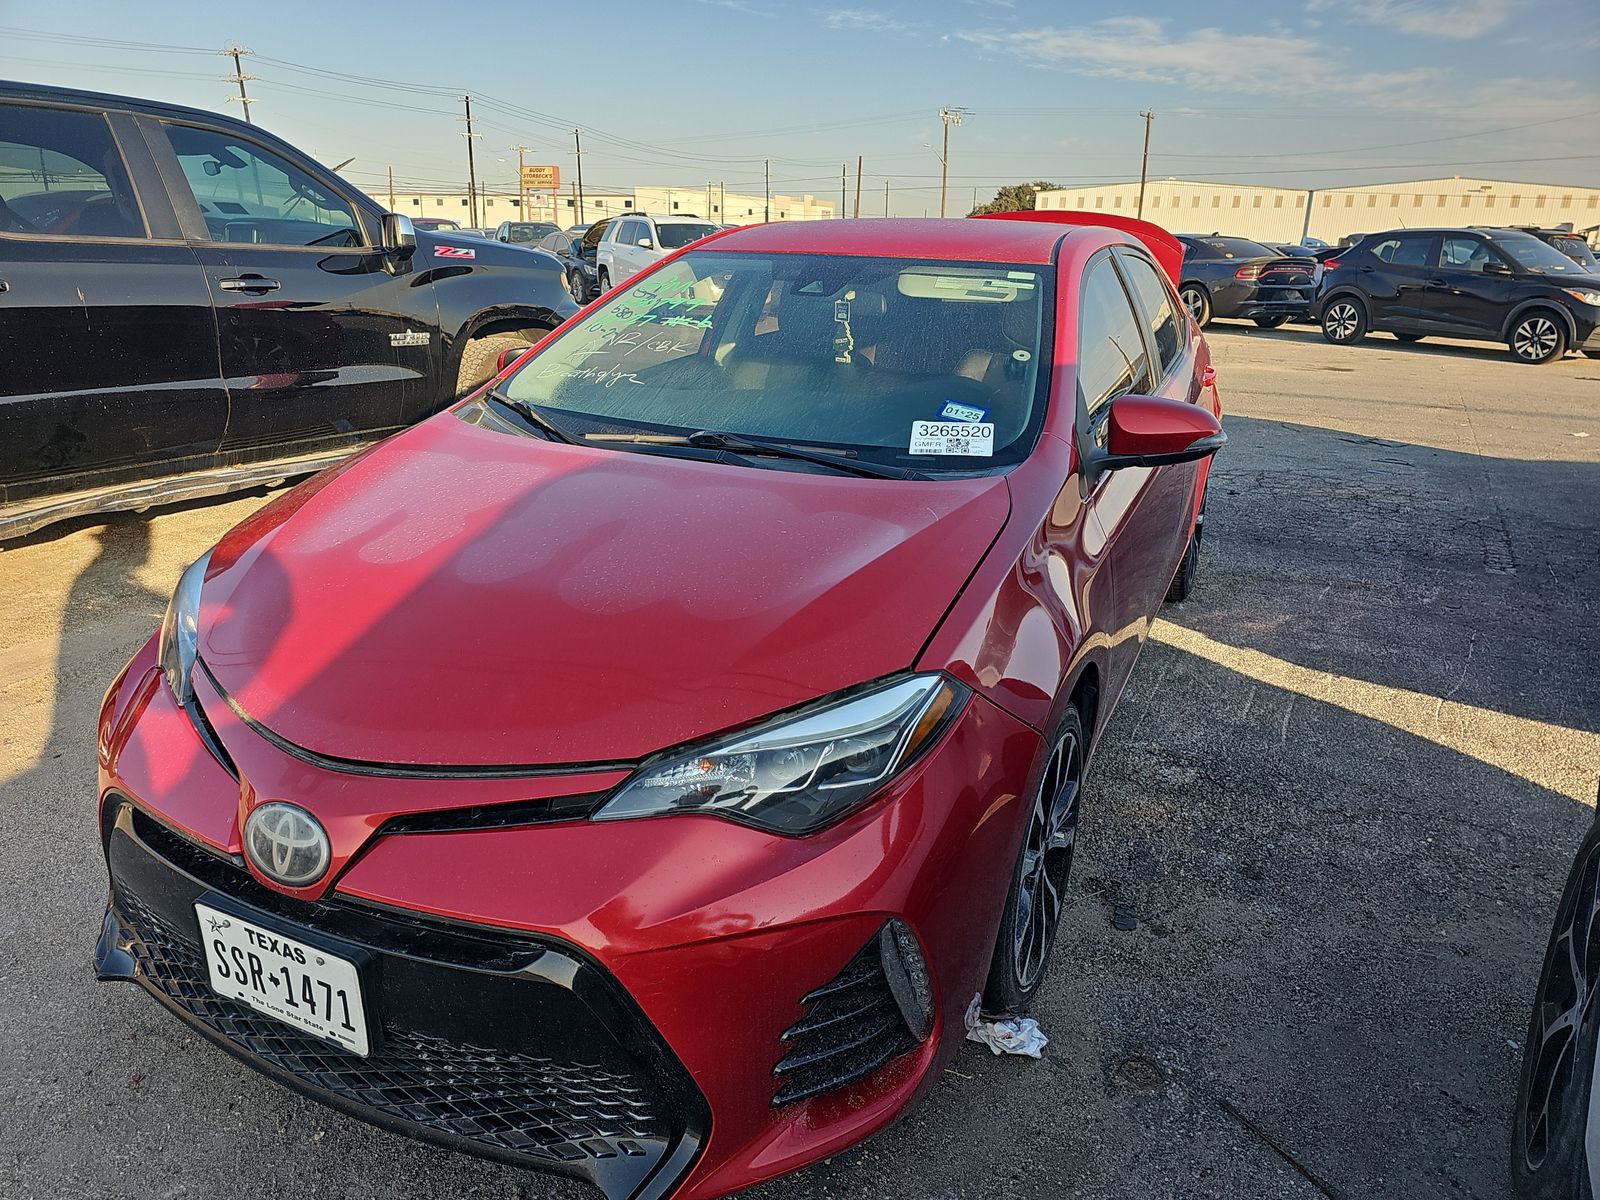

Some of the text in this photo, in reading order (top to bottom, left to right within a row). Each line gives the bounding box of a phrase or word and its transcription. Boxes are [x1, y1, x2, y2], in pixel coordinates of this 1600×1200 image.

[919, 424, 991, 438] 3265520
[244, 927, 306, 965] TEXAS
[251, 995, 324, 1031] The Lone Star State
